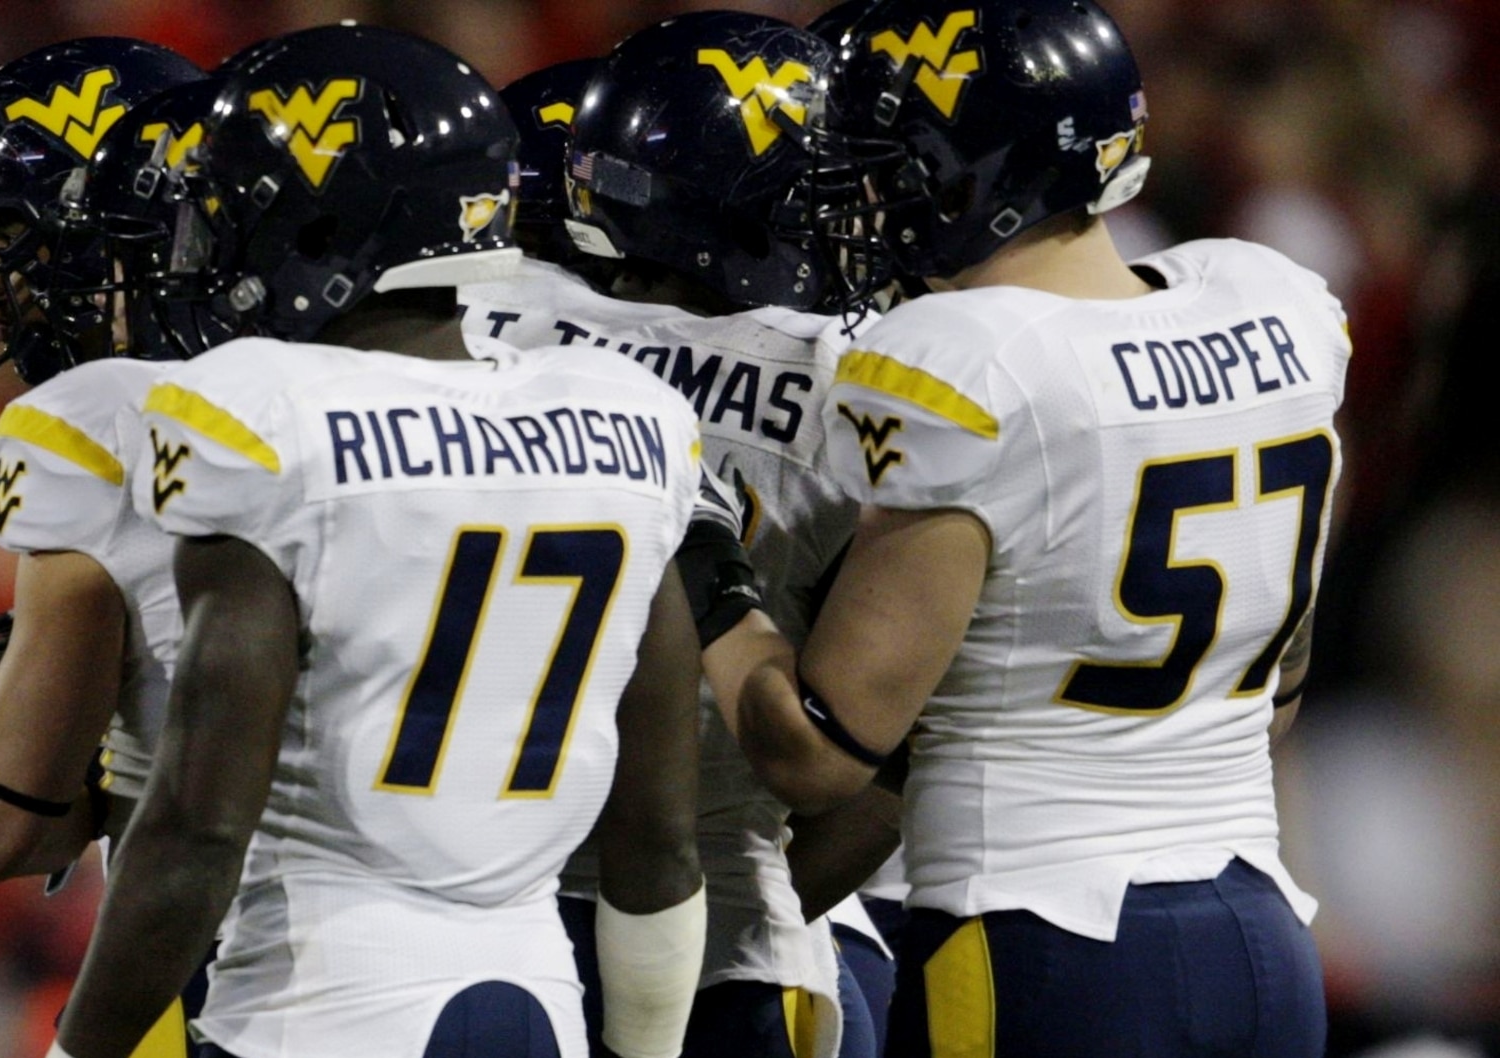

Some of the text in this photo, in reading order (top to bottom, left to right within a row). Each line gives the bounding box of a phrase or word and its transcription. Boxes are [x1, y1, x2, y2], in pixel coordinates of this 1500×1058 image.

[554, 320, 812, 444] TMAS
[1111, 315, 1311, 410] COOPER
[326, 406, 667, 490] RICHARDSON
[1054, 427, 1336, 717] 57
[371, 521, 630, 801] 17
